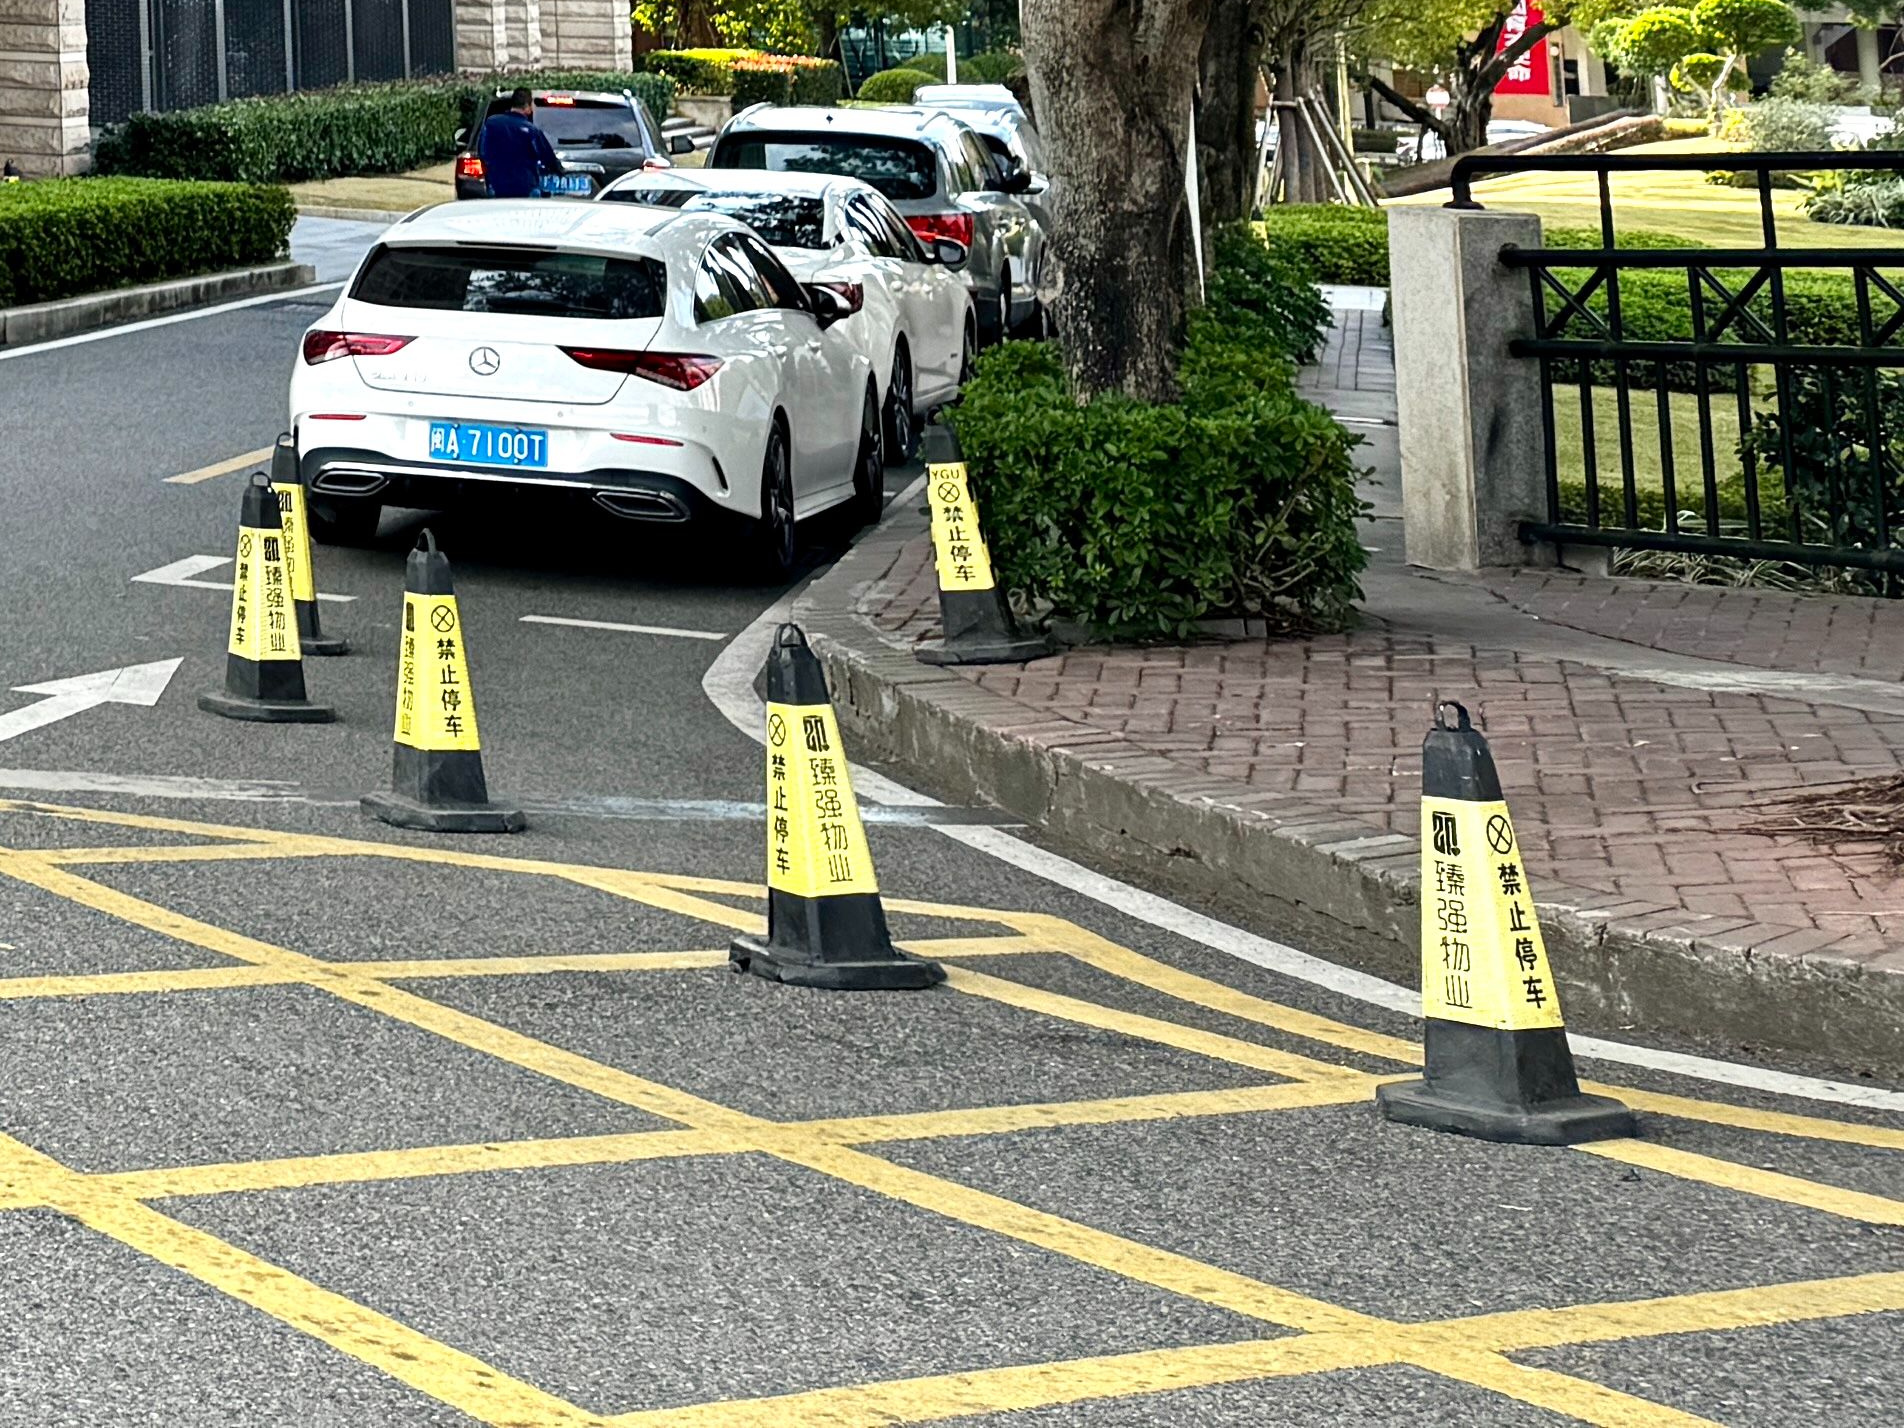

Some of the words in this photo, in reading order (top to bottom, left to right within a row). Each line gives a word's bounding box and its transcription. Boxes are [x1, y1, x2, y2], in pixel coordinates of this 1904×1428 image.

[932, 469, 959, 480] YGU
[943, 506, 976, 581] 禁止停车
[436, 638, 464, 738] 禁止停车
[772, 754, 790, 876] 禁止停车
[808, 758, 853, 882] 臻强物业
[1434, 859, 1473, 1009] 臻强物业
[1497, 862, 1547, 1009] 禁止停车
